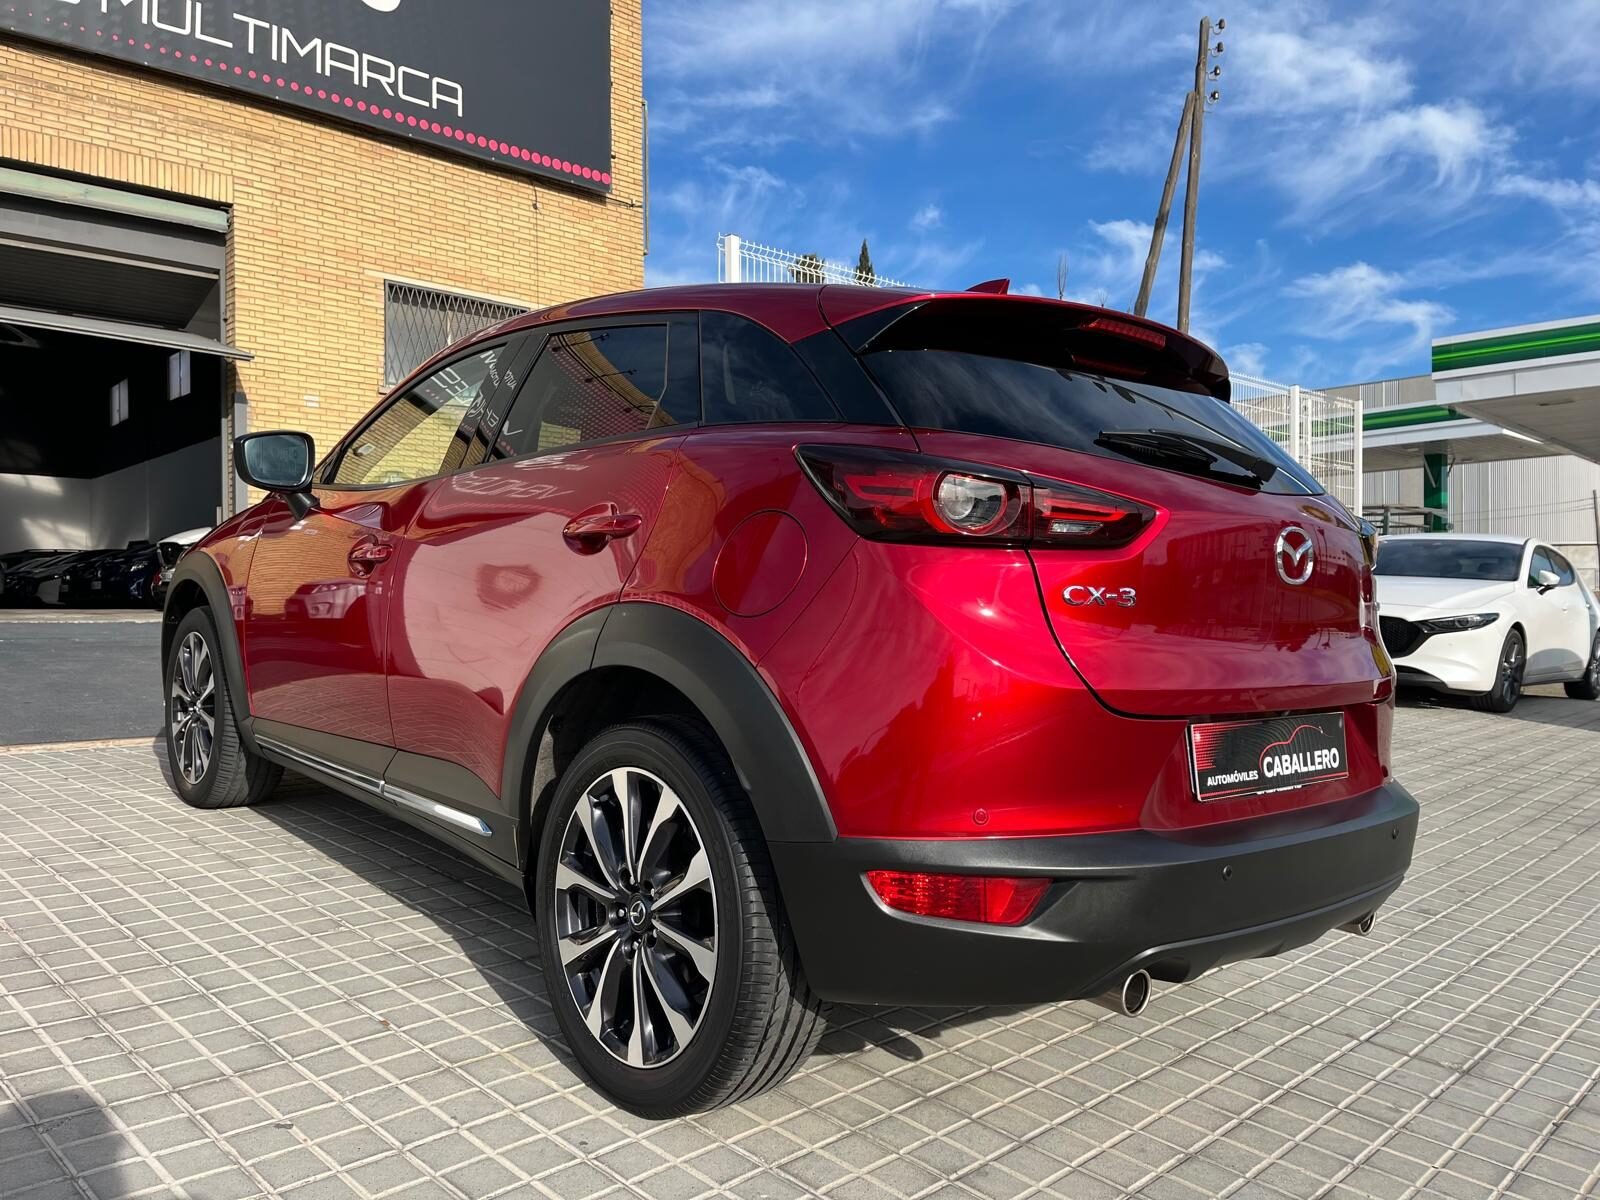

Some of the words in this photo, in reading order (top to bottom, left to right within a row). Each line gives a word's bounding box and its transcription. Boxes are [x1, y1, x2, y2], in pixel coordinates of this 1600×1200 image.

[1062, 585, 1137, 607] CX-3
[1207, 770, 1259, 786] AUTOMÓVILES
[1263, 747, 1340, 777] CABALLERO
